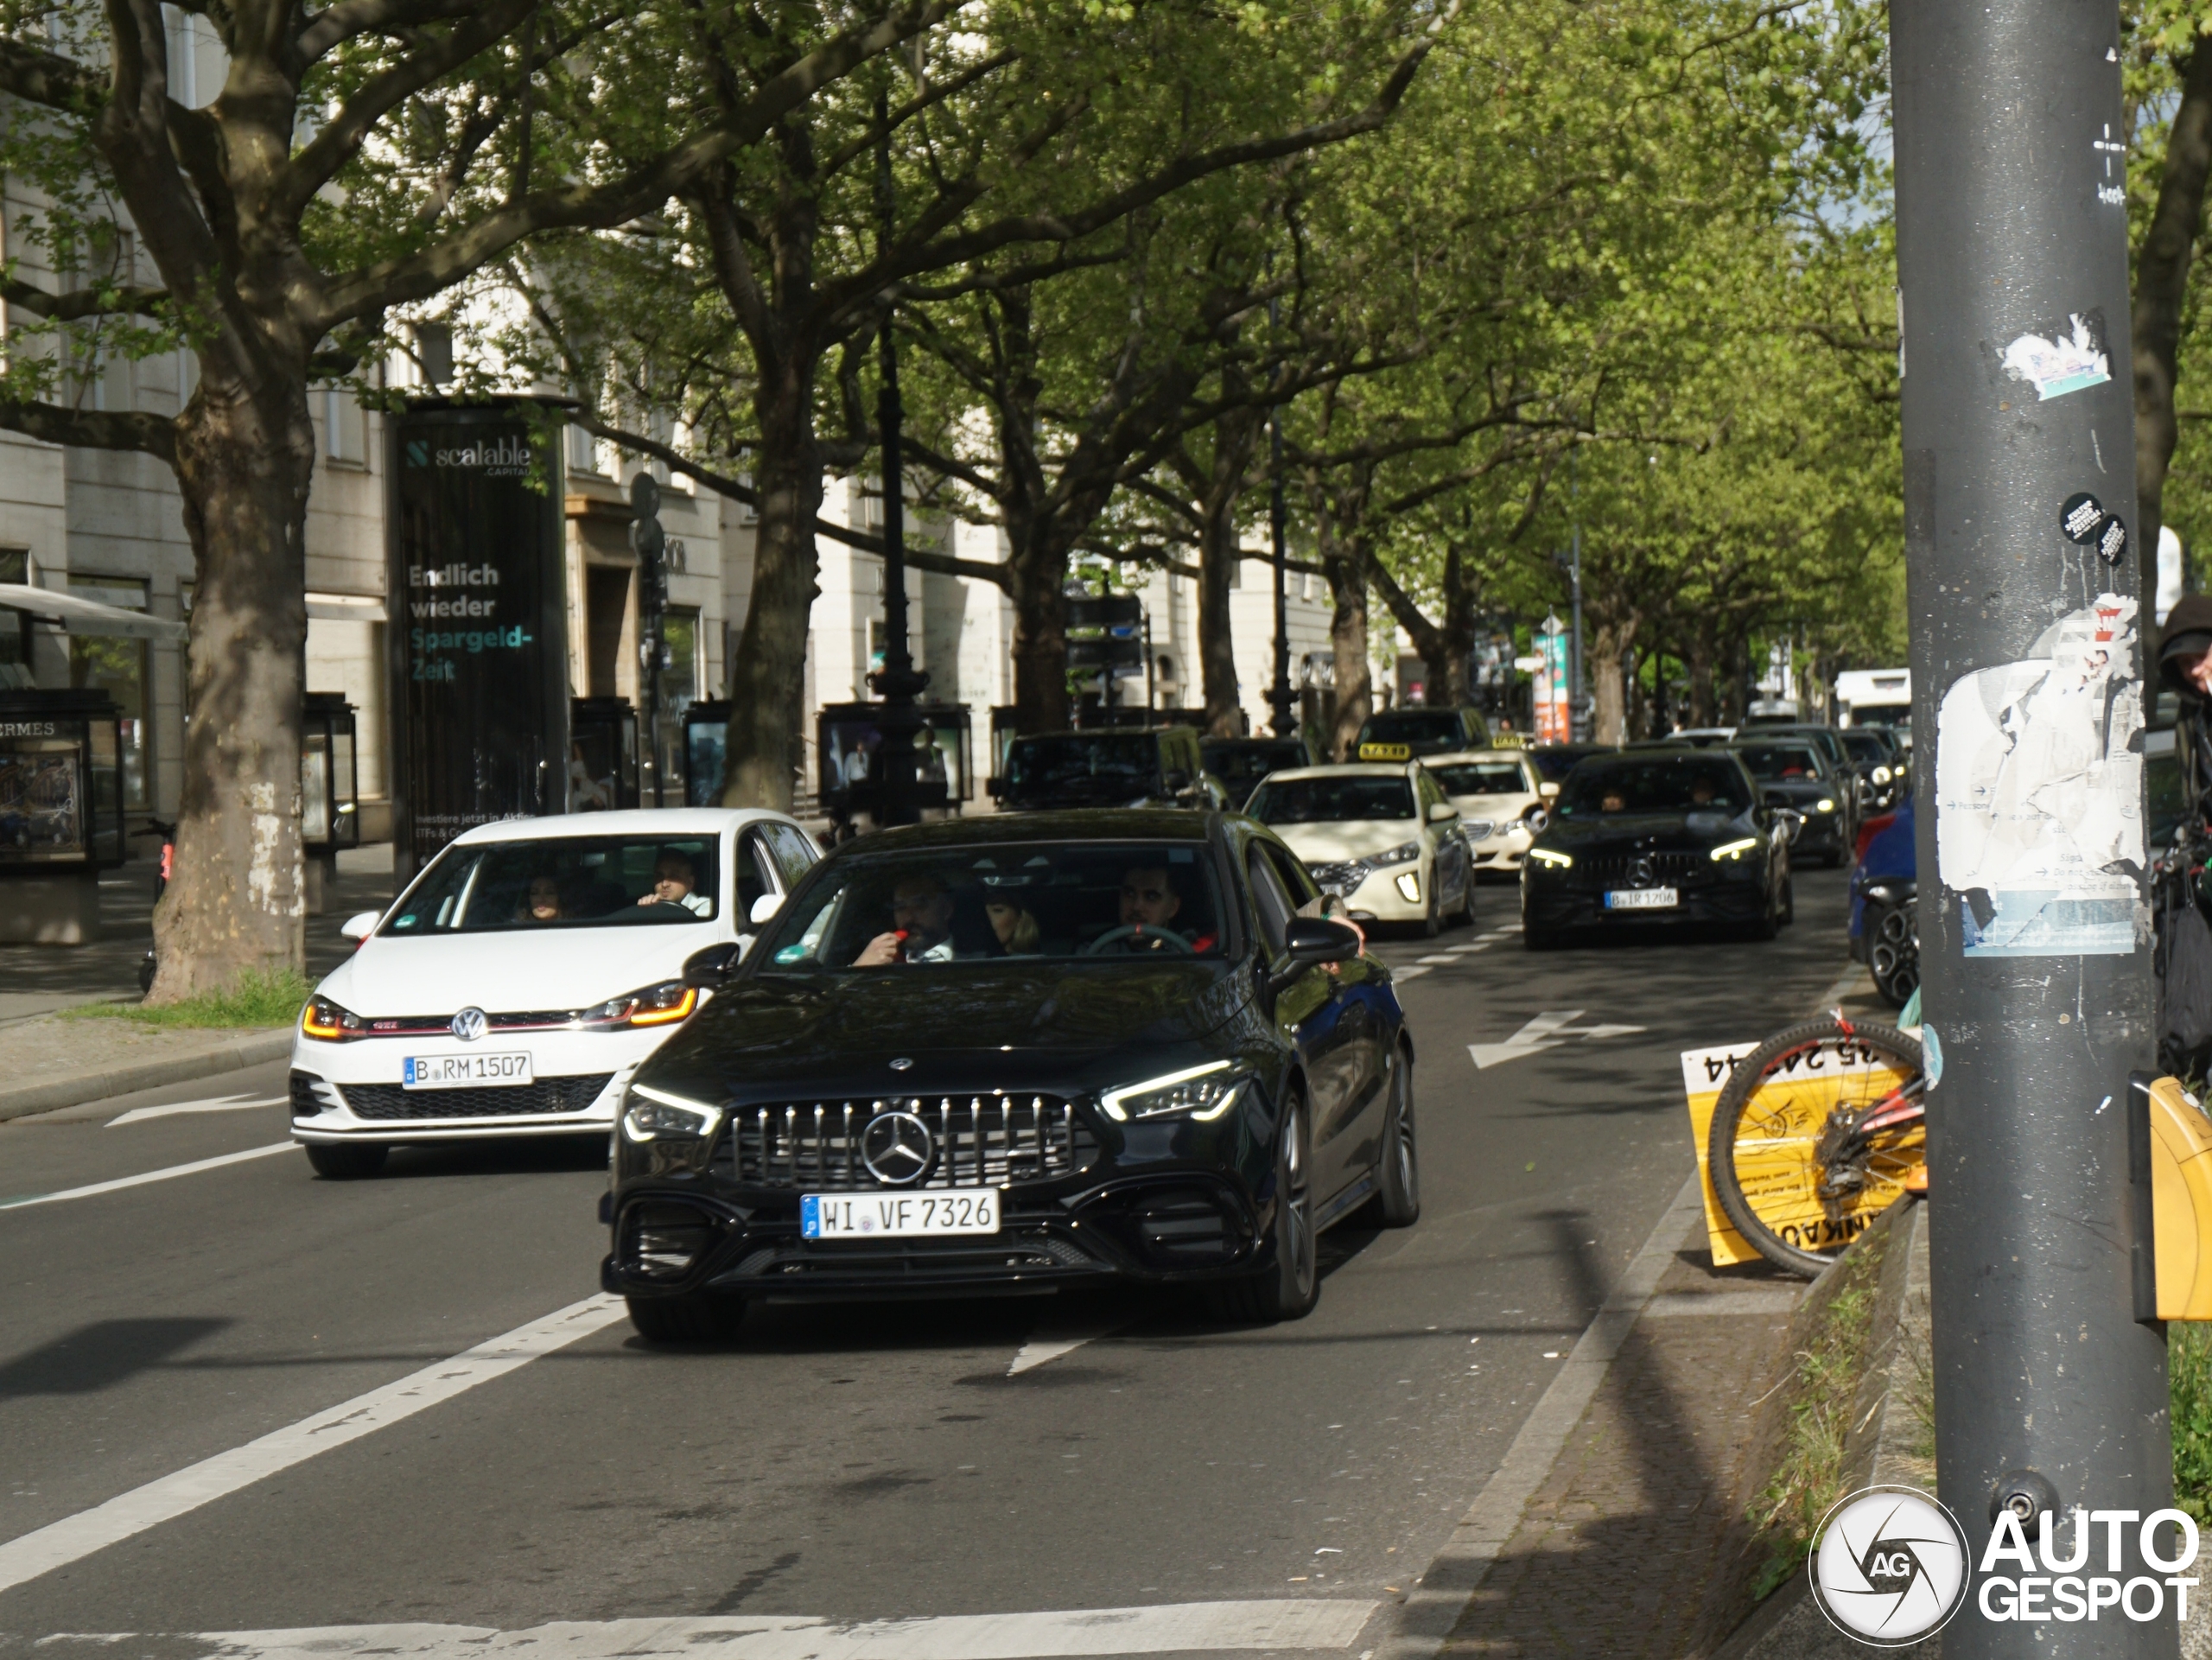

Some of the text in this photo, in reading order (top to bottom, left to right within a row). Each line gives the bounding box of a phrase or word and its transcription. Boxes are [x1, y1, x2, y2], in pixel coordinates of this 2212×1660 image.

[435, 435, 531, 467] scalable
[409, 563, 499, 587] Endlich
[410, 595, 496, 618] wieder
[410, 625, 532, 653] Spargeld-
[411, 658, 455, 681] Zeit
[461, 812, 486, 825] jetzt
[489, 812, 499, 822] in
[416, 1056, 526, 1080] B RM 1507
[823, 1198, 991, 1231] WI VF 7326
